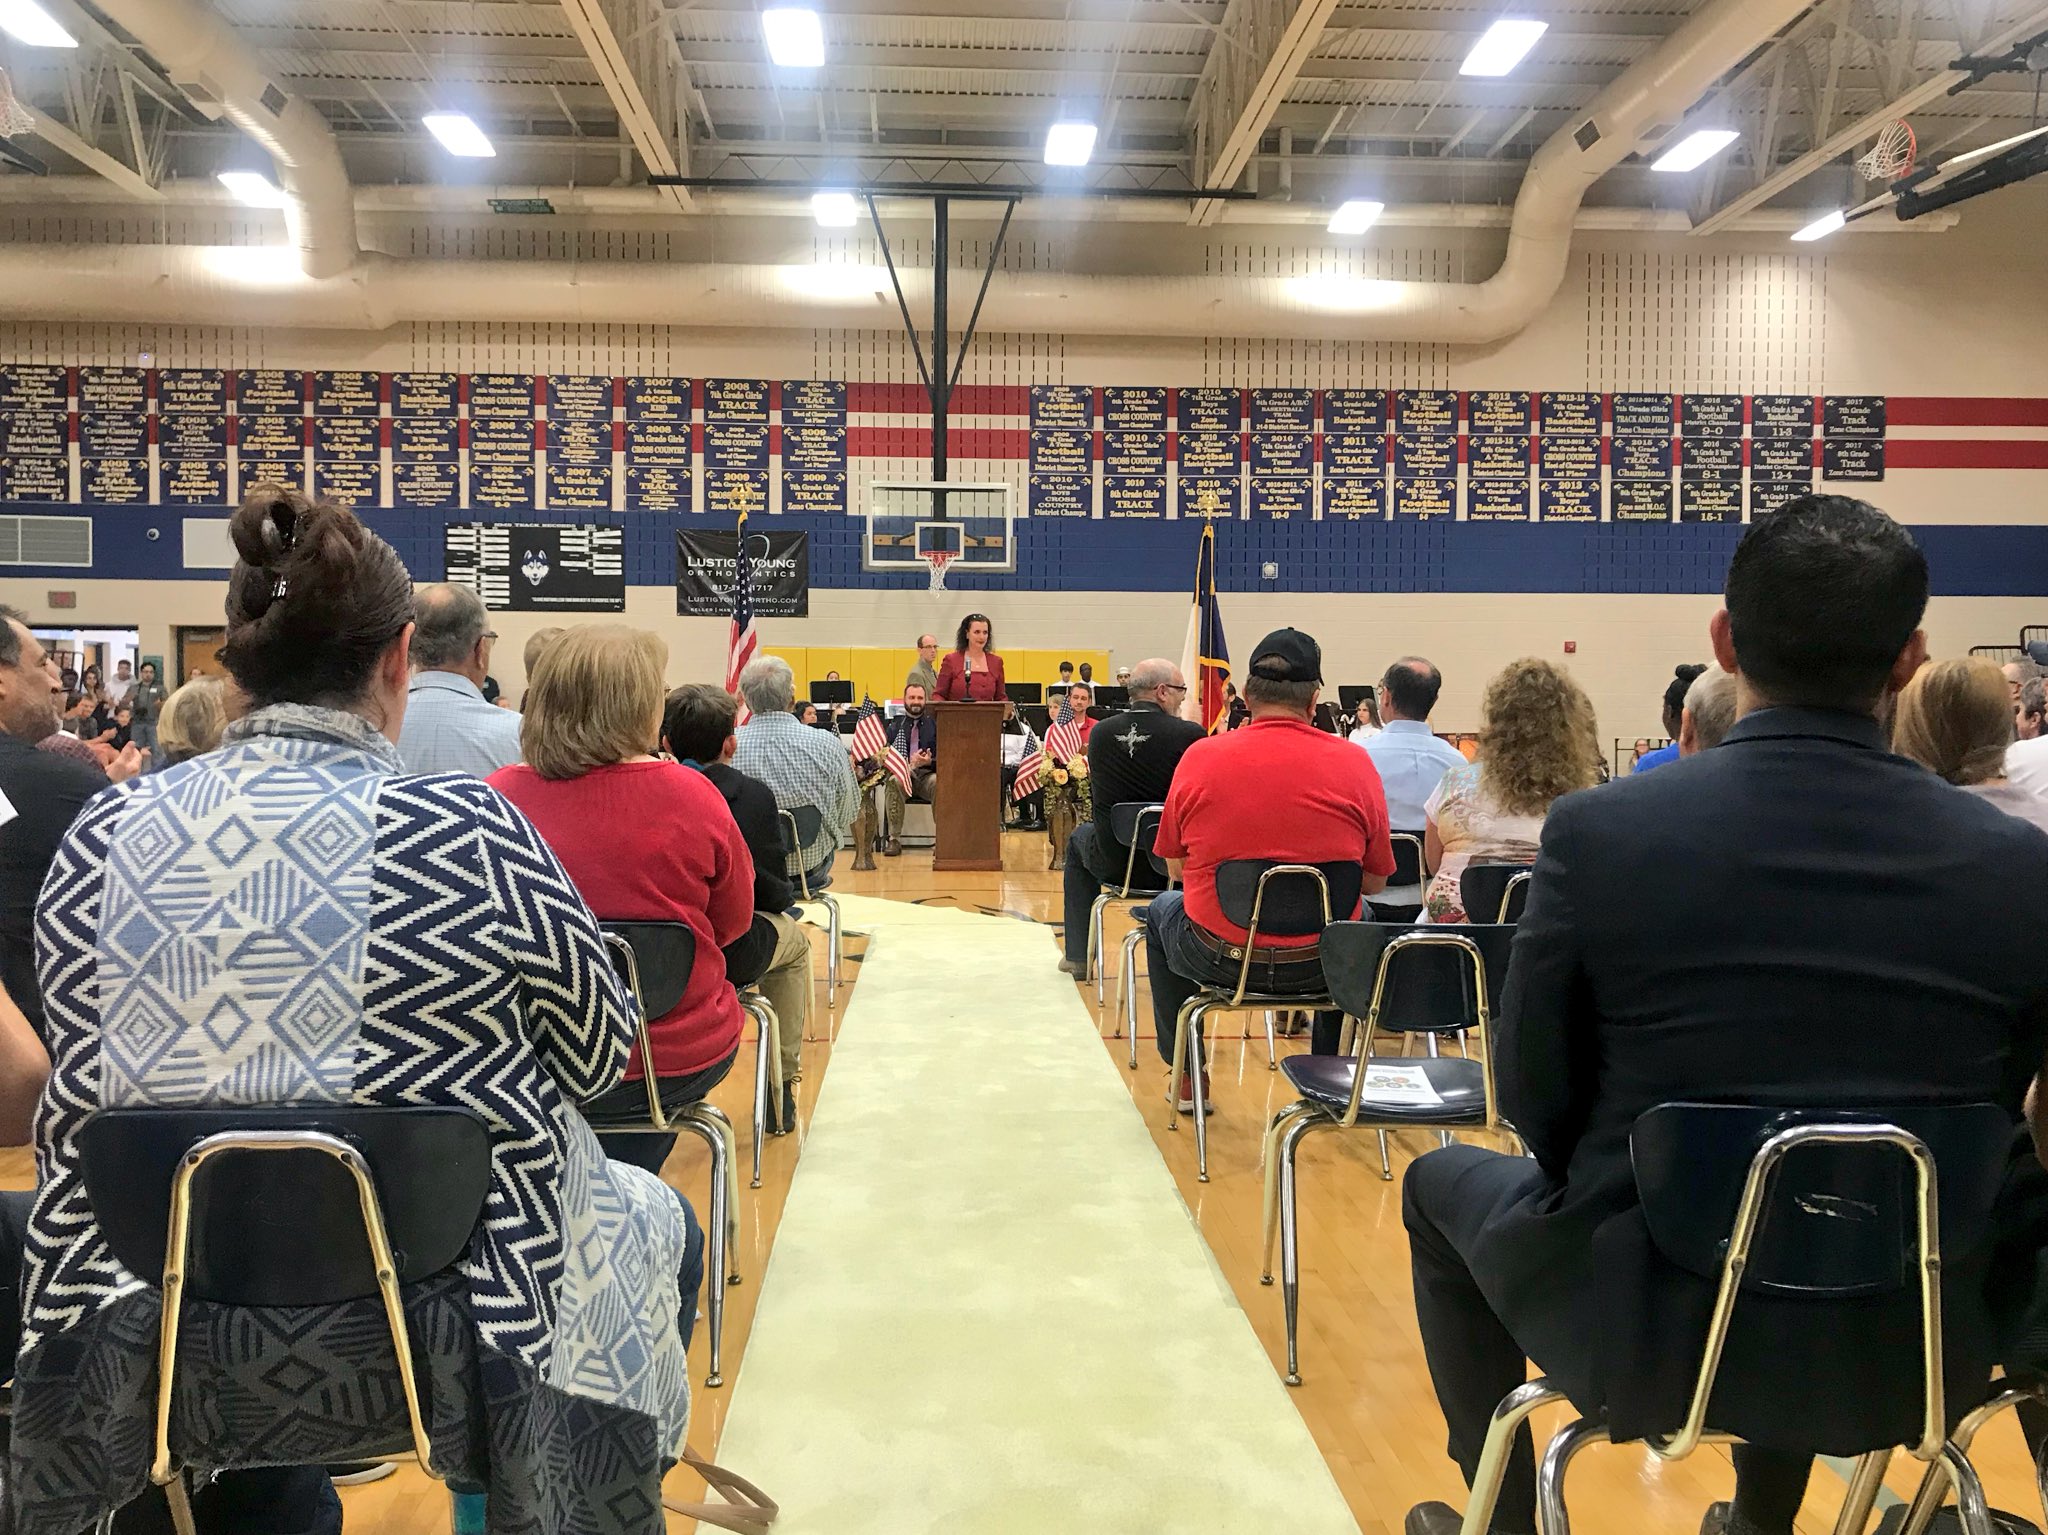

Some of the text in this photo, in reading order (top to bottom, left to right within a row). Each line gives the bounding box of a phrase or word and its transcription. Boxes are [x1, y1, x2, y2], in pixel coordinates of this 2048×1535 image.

[636, 396, 682, 404] SOCCER
[727, 412, 766, 420] Champions
[1842, 416, 1867, 424] Track
[1702, 427, 1723, 435] 9-0
[1773, 428, 1792, 436] 11-3
[1343, 437, 1366, 445] 2011
[1618, 470, 1665, 478] Champions
[559, 487, 598, 495] TRACK
[795, 492, 834, 500] TRACK
[805, 503, 842, 511] Champions
[1060, 509, 1086, 517] Champs
[1617, 511, 1667, 520] Champions
[688, 556, 736, 567] LUSTIG
